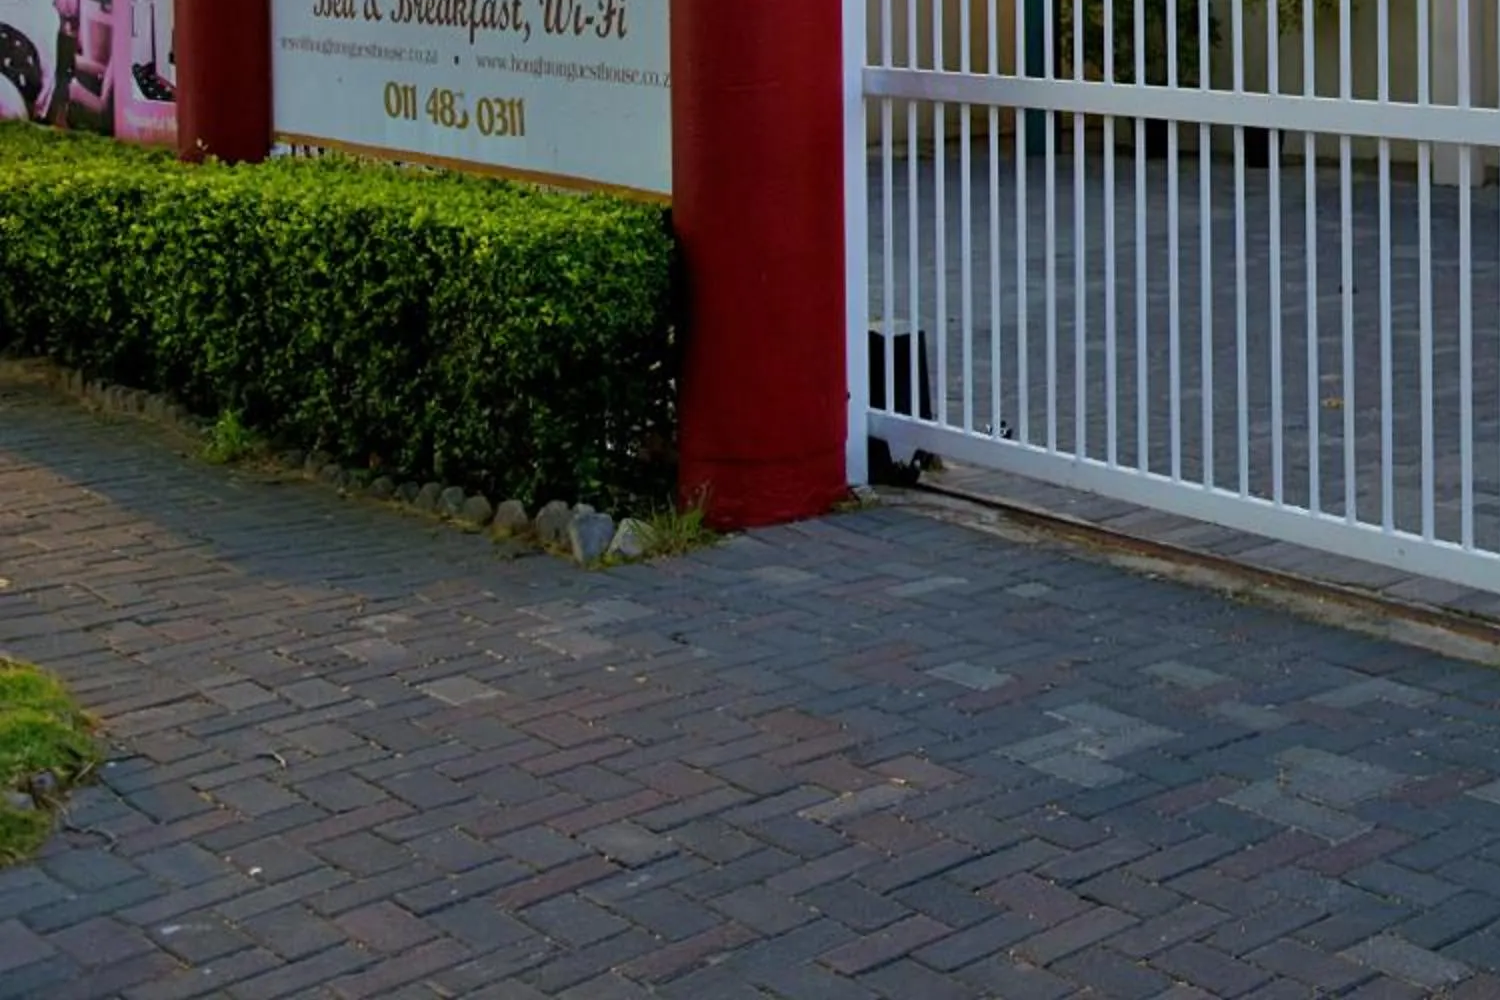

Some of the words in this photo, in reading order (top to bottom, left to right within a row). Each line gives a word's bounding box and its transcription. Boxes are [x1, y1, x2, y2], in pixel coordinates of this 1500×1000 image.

[476, 54, 672, 88] www.houghtonguesthouse.co.z
[384, 81, 417, 120] 011
[477, 97, 525, 137] 0311
